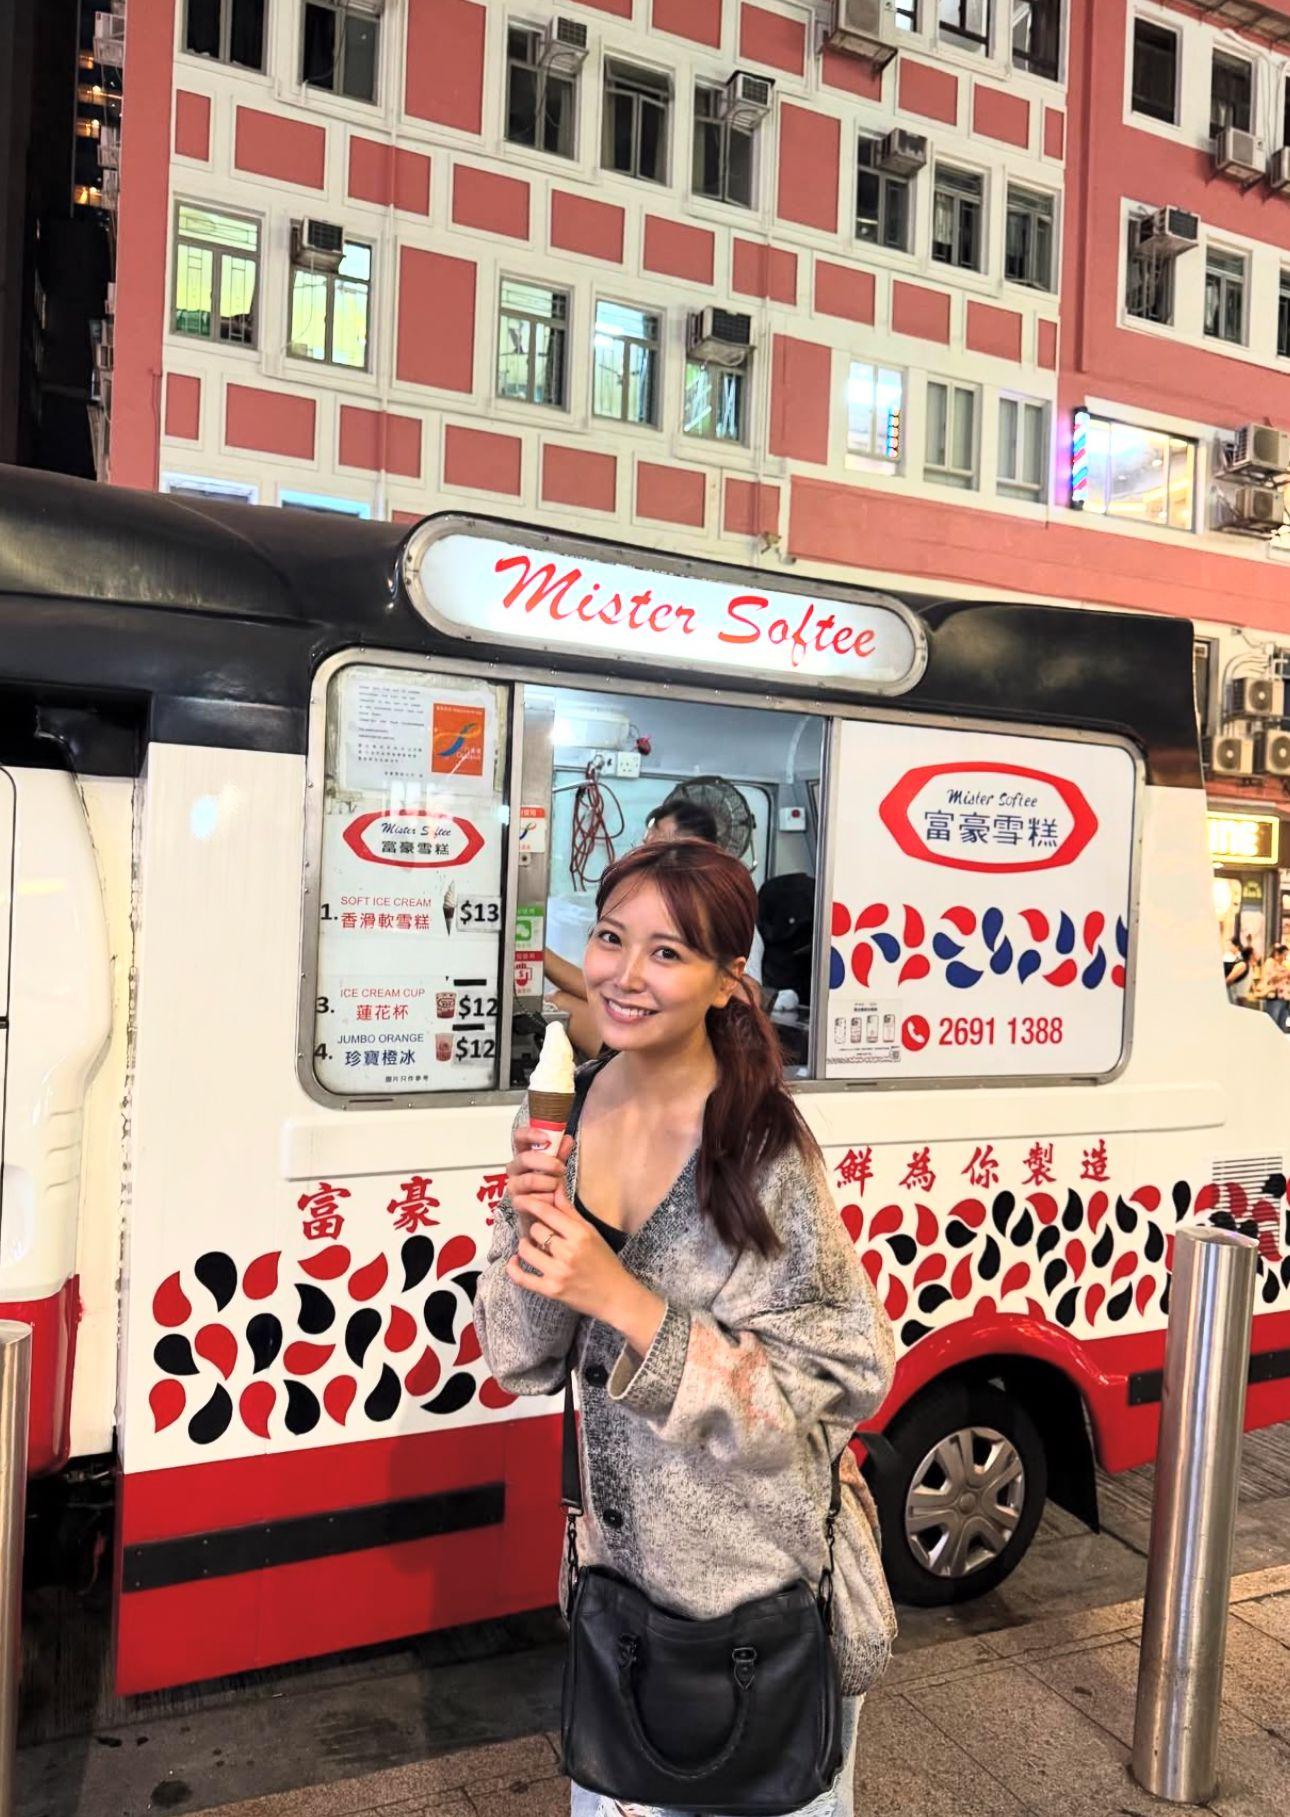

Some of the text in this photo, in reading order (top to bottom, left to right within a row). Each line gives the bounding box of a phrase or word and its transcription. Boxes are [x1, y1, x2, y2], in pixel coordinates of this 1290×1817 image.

[494, 555, 876, 667] Mister Softee
[947, 788, 1038, 808] Mister Softee
[381, 822, 452, 839] Mister Sftee
[924, 810, 1059, 848] 富豪雪糕
[381, 840, 450, 856] 富豪雪糕
[340, 896, 432, 907] SOFT ICE CREAM
[320, 904, 338, 920] 1.
[460, 900, 499, 925] $13
[341, 912, 430, 930] 香滑軟雪糕
[340, 988, 425, 998] ICE CREAM CUP
[316, 997, 335, 1013] 3.
[356, 1004, 409, 1021] 蓮花杯
[459, 996, 498, 1019] $12
[337, 1033, 424, 1044] JUMBO ORANGE
[939, 1017, 1063, 1045] 2691 1388
[314, 1043, 333, 1060] 4.
[345, 1050, 416, 1067] 珍寶橙冰
[455, 1038, 495, 1062] $12
[833, 1138, 1112, 1196] 鮮為你製造
